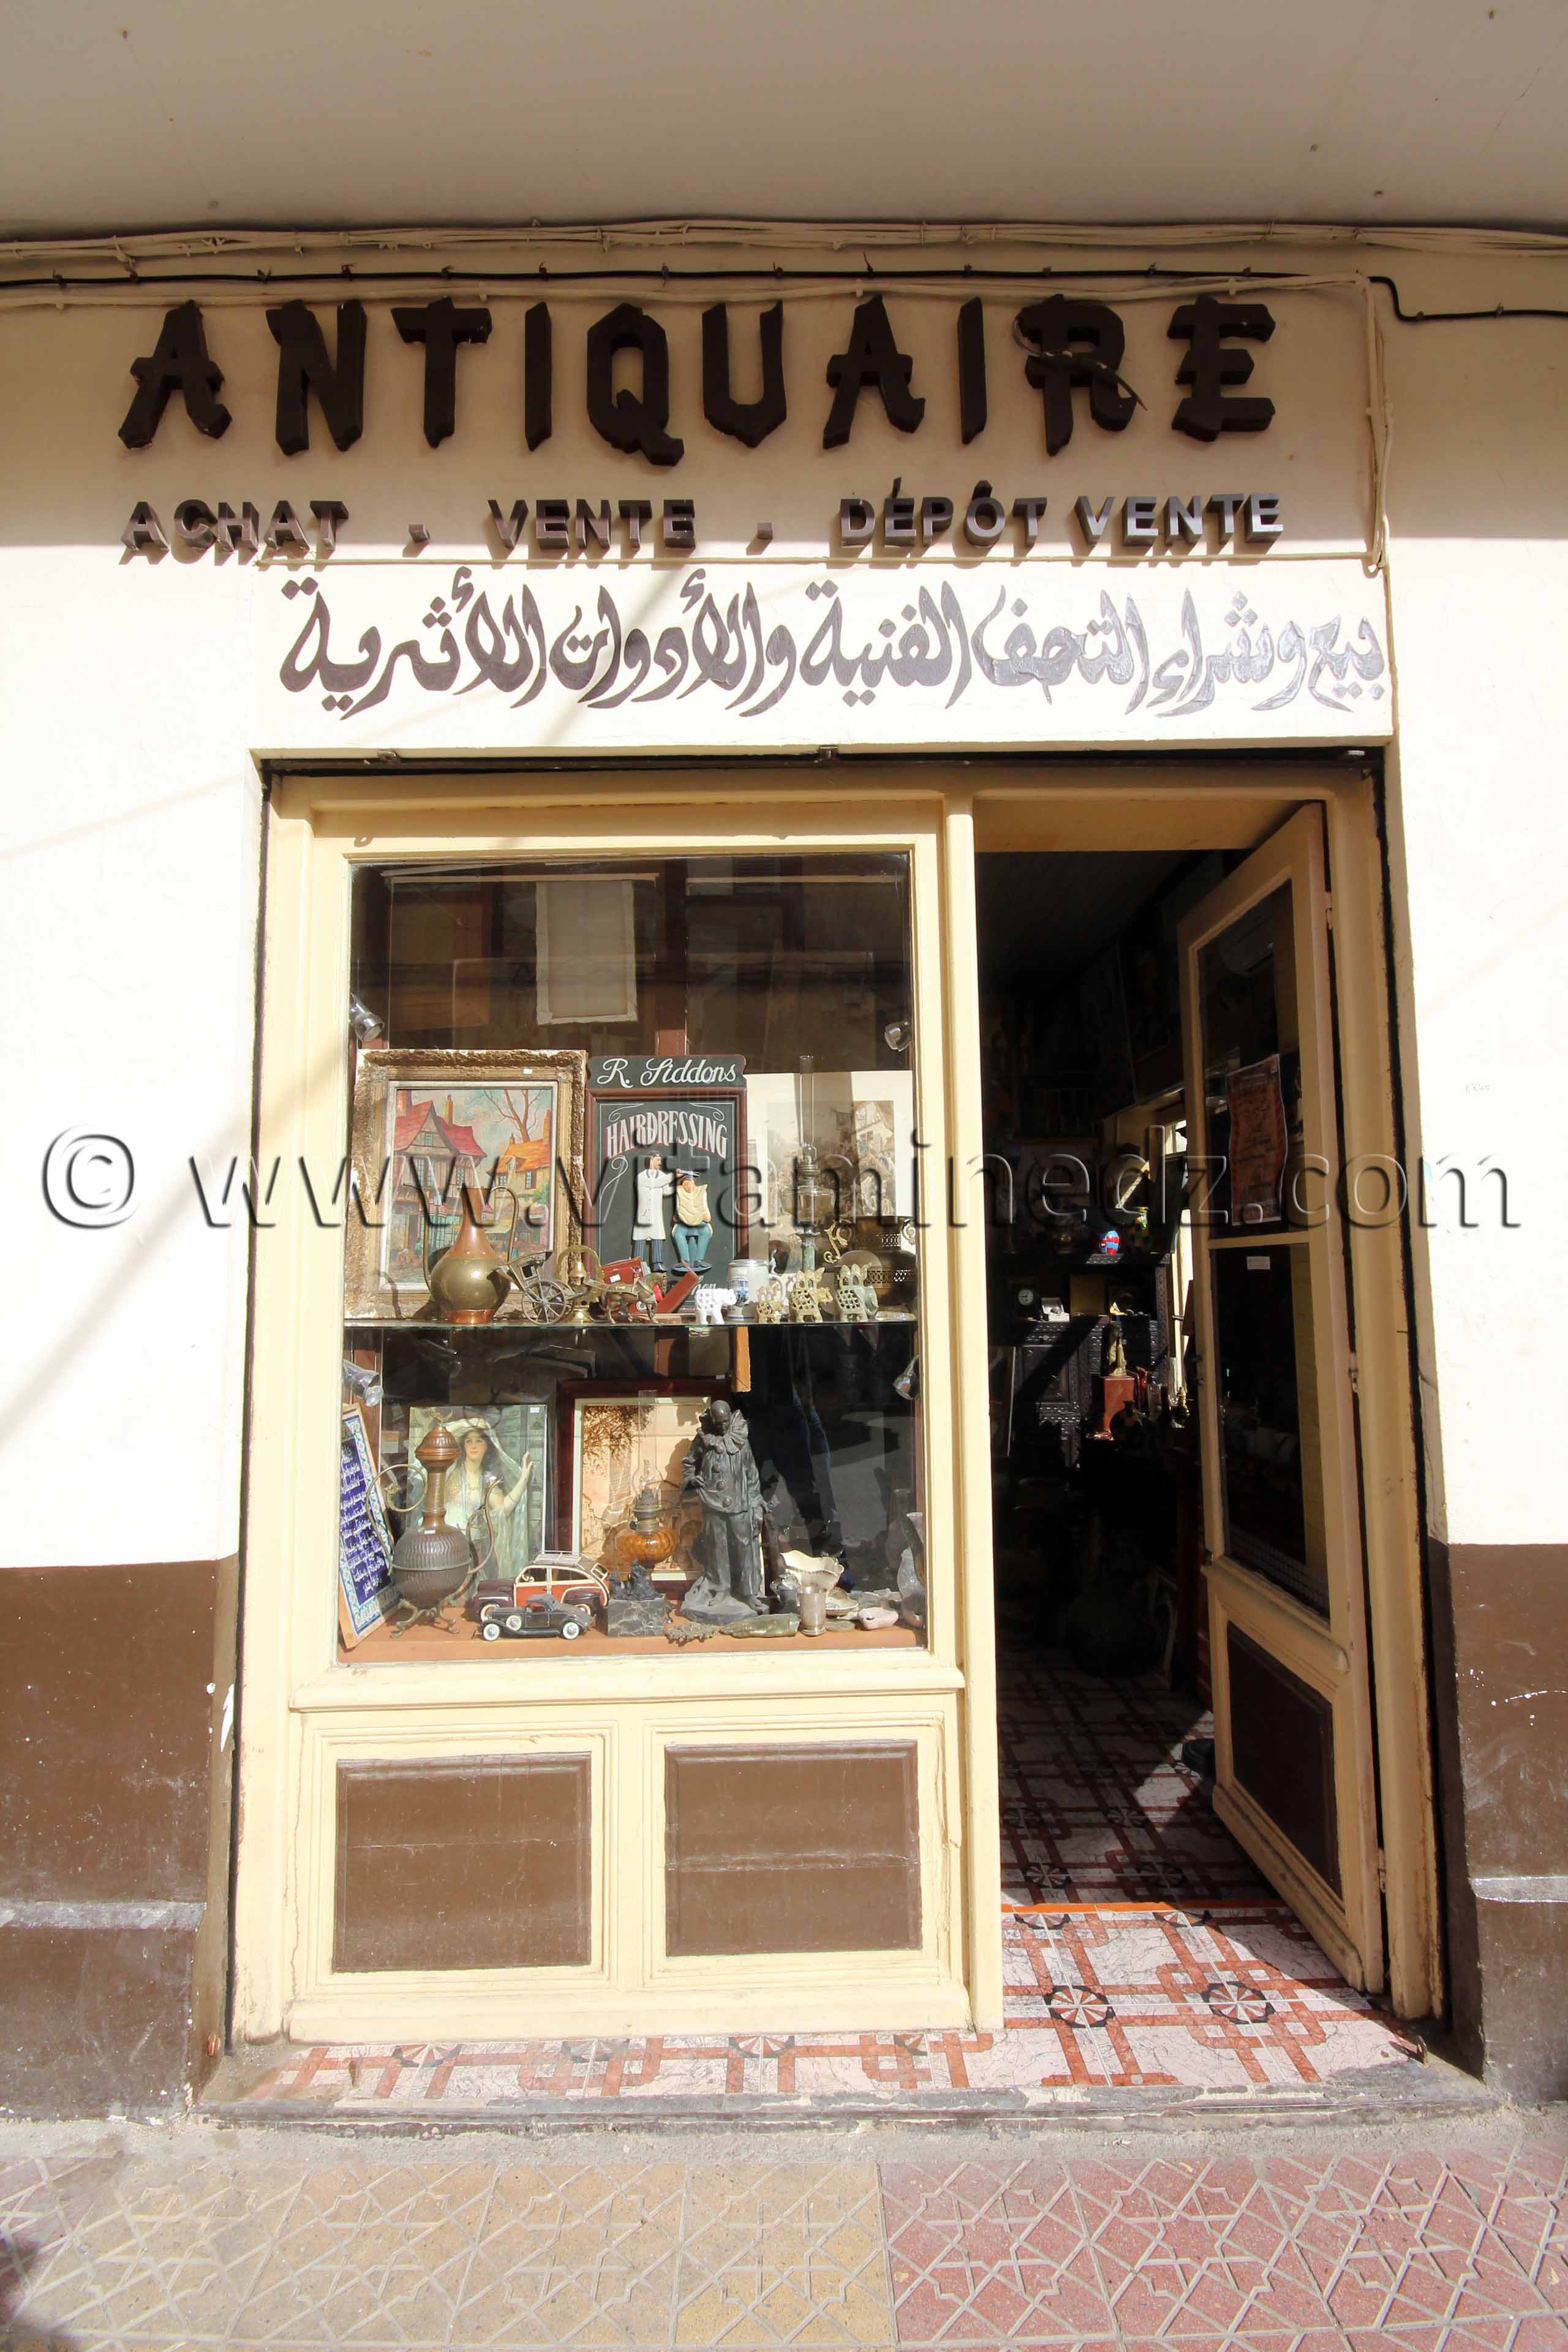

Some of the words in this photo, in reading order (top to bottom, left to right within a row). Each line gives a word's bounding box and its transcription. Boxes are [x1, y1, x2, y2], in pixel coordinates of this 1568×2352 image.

[118, 294, 1276, 466] ANTIQUAIRE
[121, 499, 349, 554] ACHAT
[488, 499, 696, 550] VENTE
[1074, 492, 1284, 546] VENTE
[799, 579, 973, 709] الفنية
[1308, 614, 1385, 713] بيع
[597, 1058, 633, 1088] R.
[640, 1058, 736, 1087] Siddons
[605, 1109, 728, 1161] HAIRDRESSING
